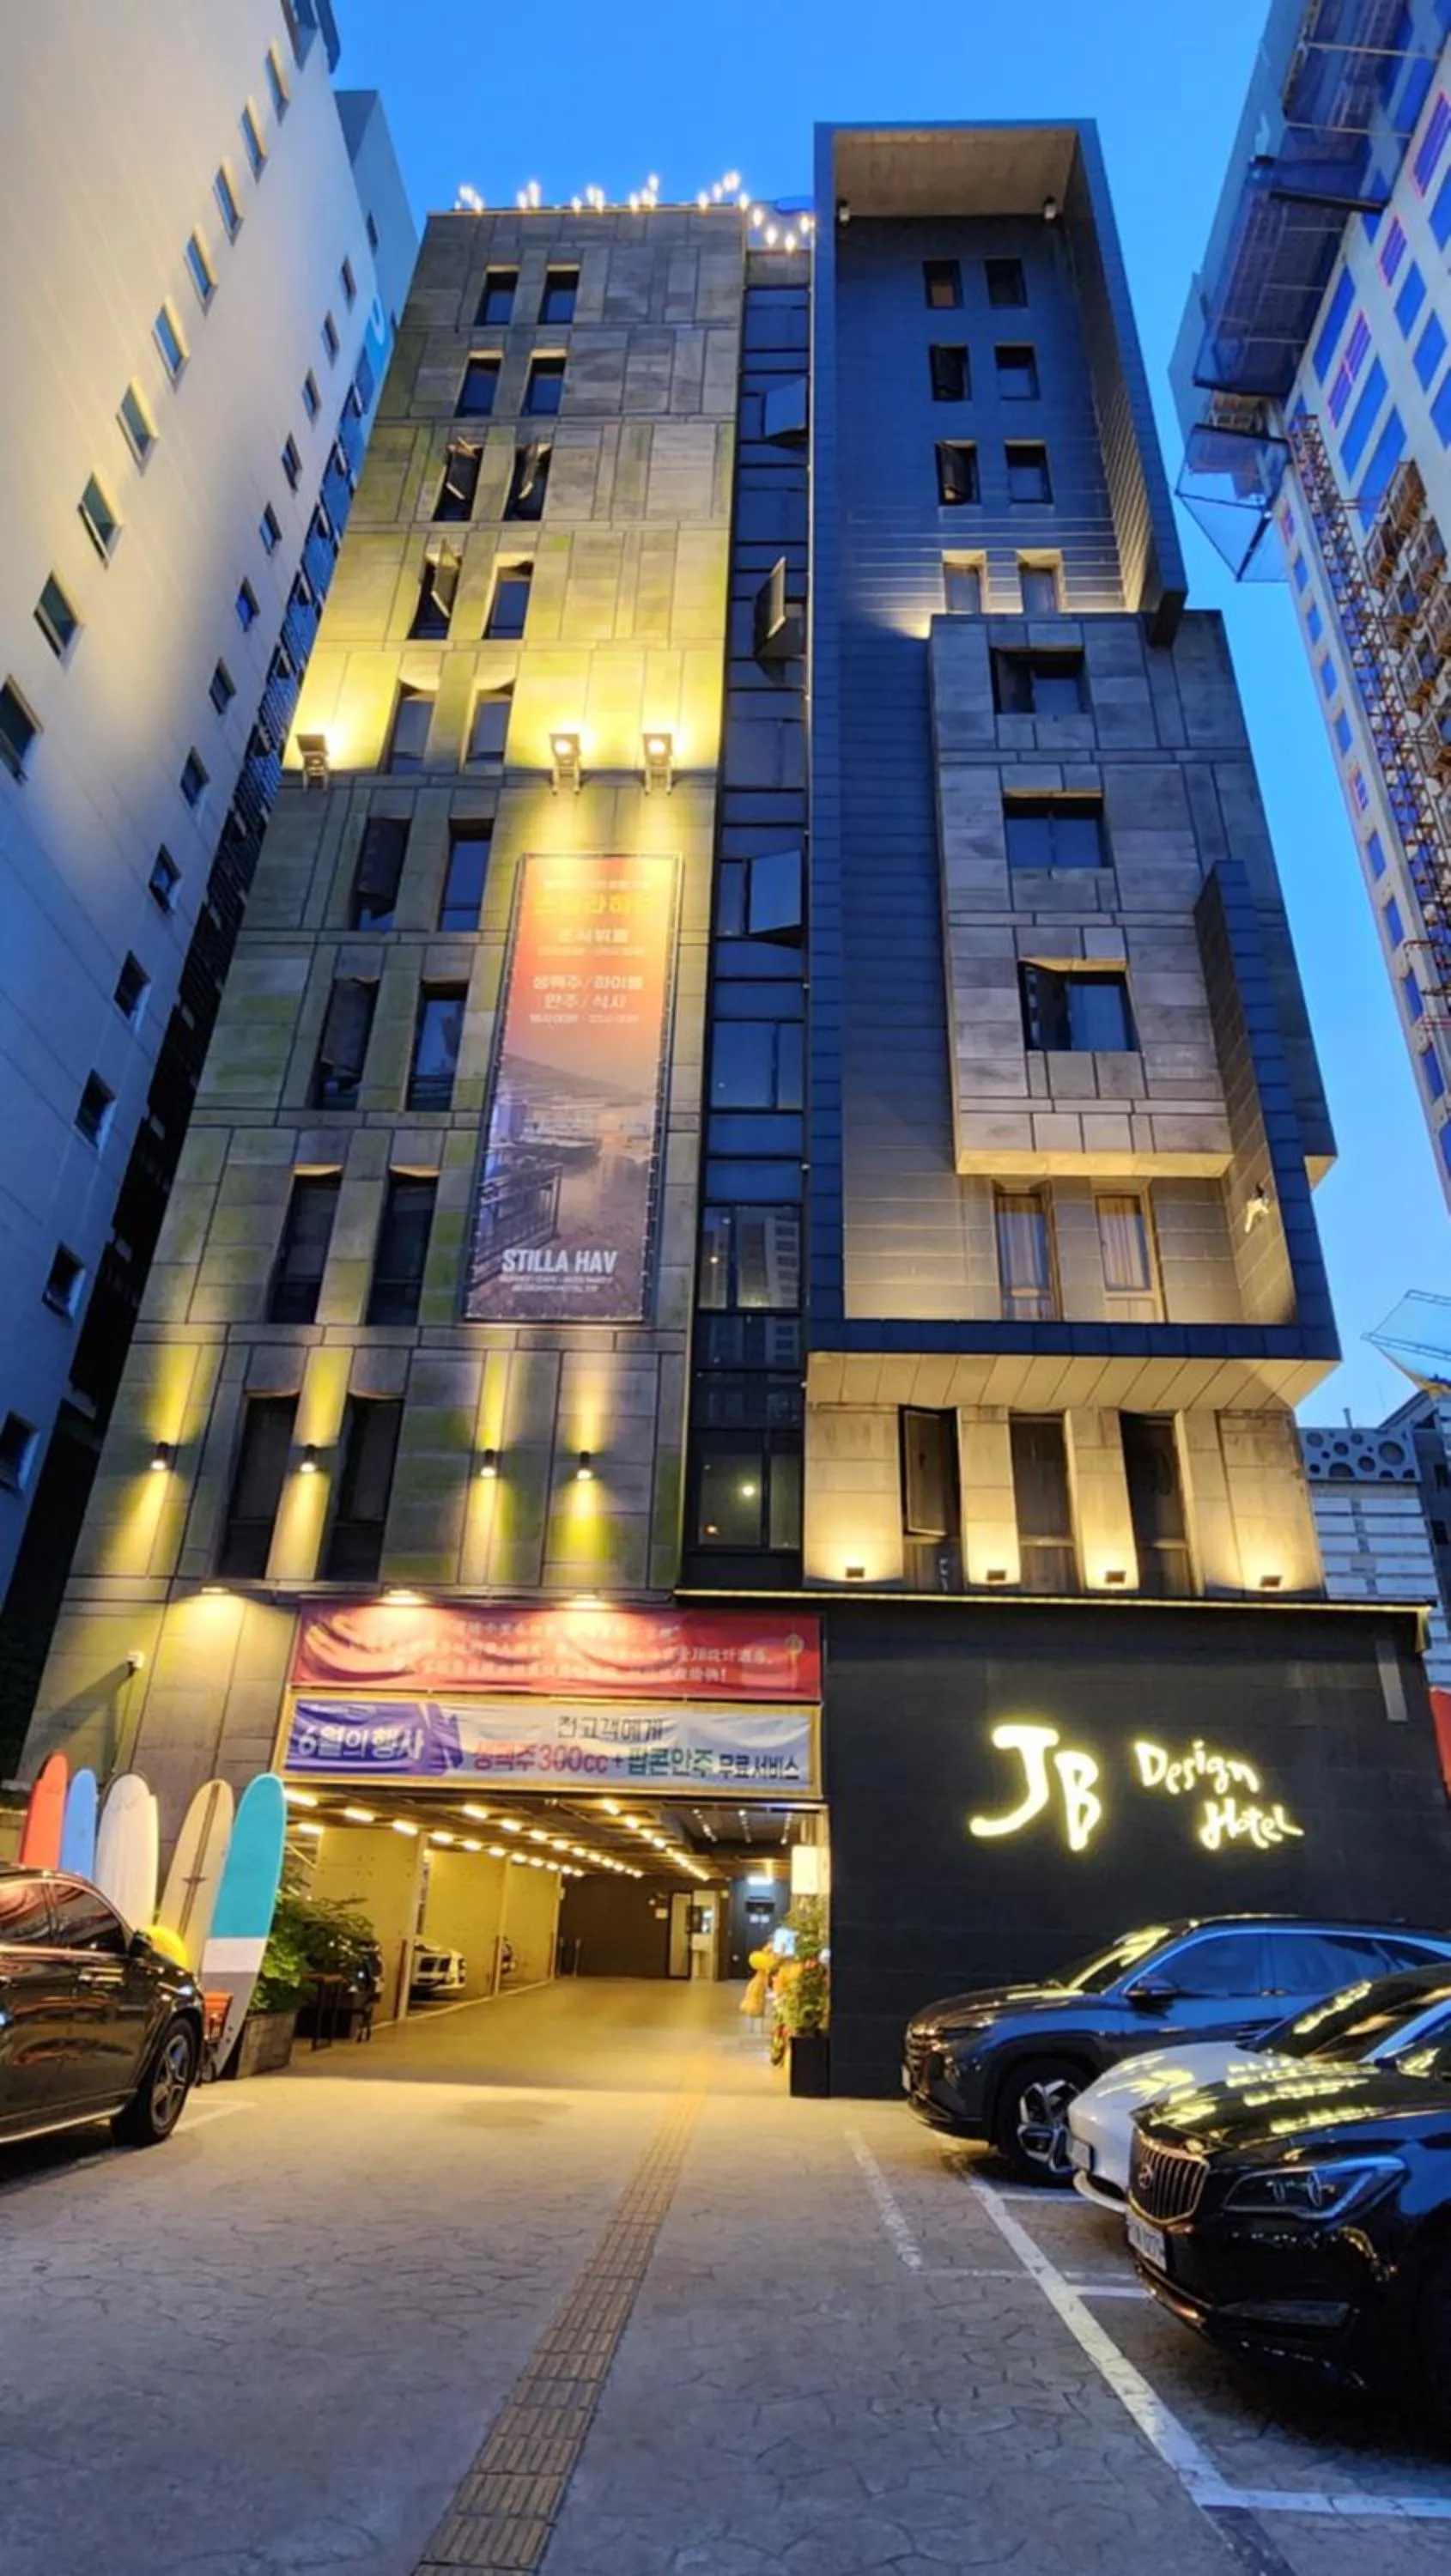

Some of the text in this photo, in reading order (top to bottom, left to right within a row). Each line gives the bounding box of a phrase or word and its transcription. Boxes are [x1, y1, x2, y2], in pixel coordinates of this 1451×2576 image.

[501, 1249, 618, 1273] STILLA HAV
[969, 1723, 1102, 1852] JB
[1133, 1739, 1260, 1795] Design
[1199, 1796, 1304, 1850] Hotel
